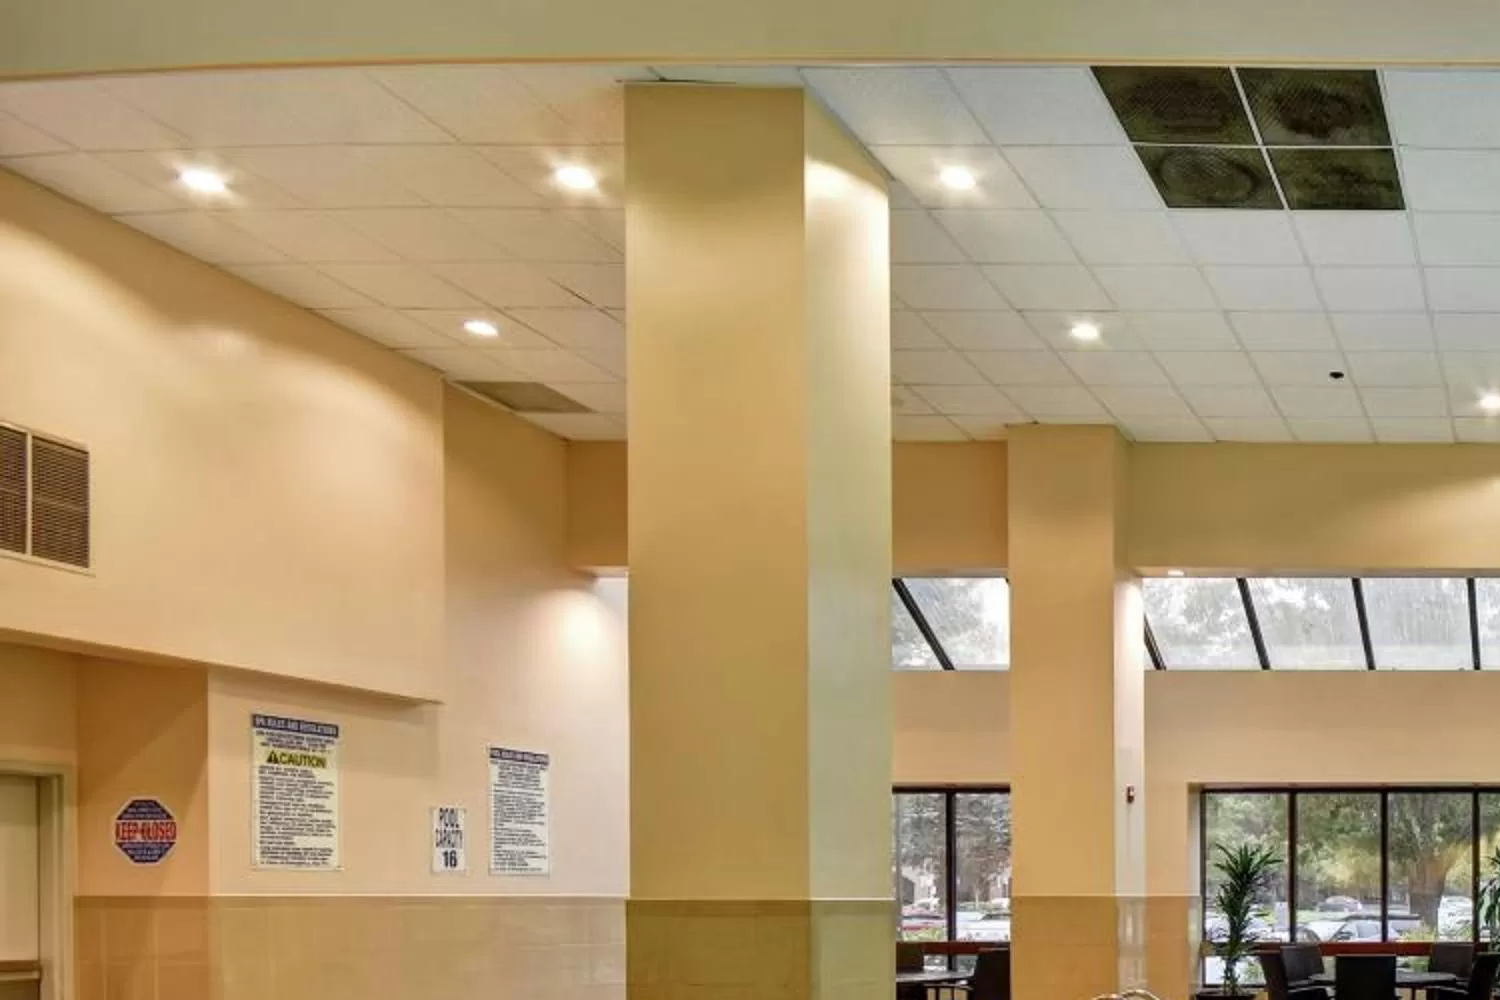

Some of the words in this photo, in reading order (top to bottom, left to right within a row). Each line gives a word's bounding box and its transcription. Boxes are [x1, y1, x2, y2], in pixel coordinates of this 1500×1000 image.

[280, 751, 327, 769] CAUTION
[439, 807, 459, 828] POOL
[435, 828, 463, 849] CAPACITY
